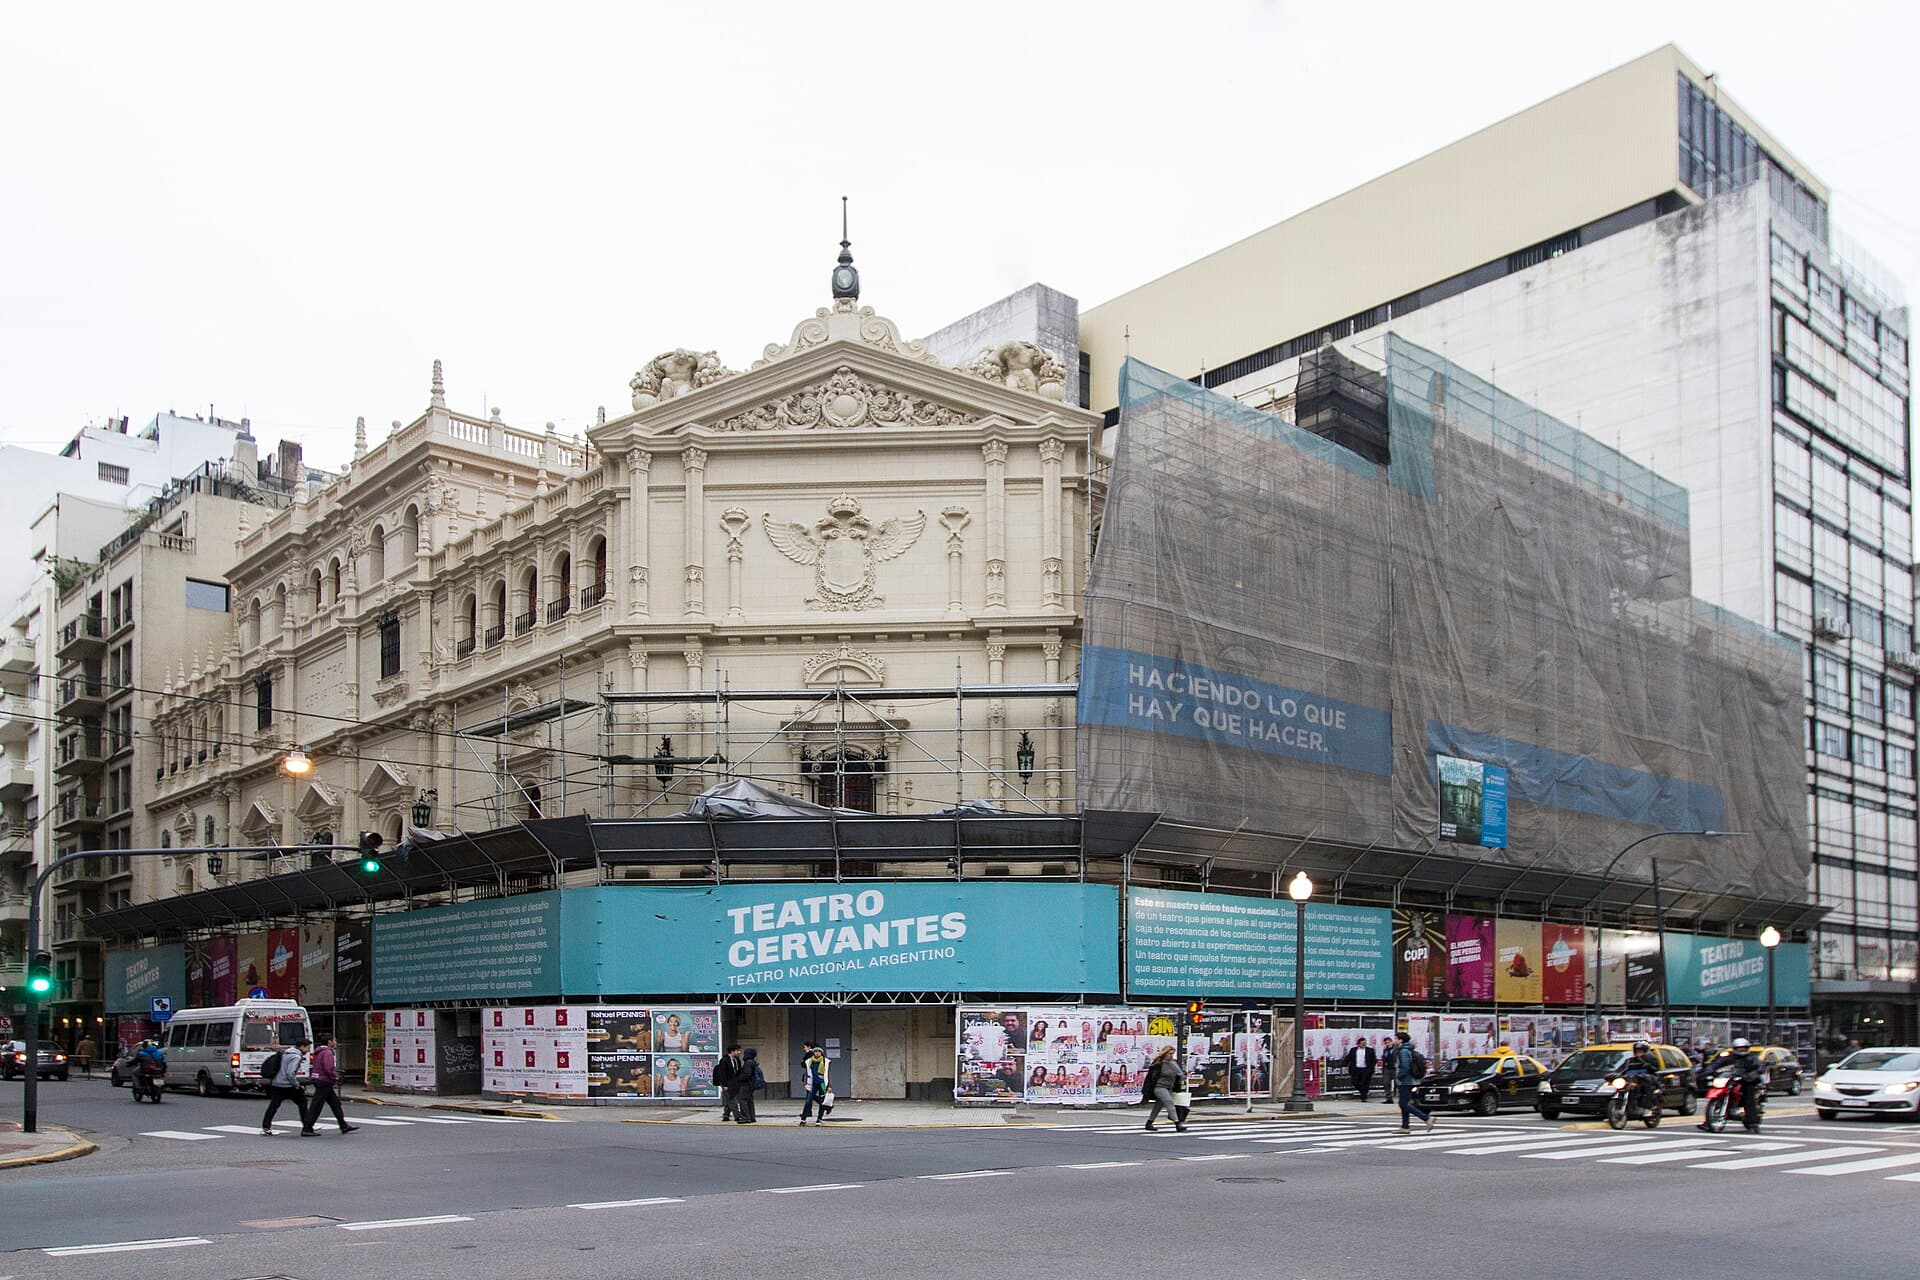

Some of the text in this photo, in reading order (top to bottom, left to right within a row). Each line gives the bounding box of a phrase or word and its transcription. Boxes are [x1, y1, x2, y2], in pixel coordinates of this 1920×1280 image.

[1130, 663, 1346, 730] HACIENDO LO QUE
[1129, 693, 1328, 752] HAY QUE HACER.
[728, 890, 884, 935] TEATRO
[1136, 910, 1145, 919] de
[1160, 913, 1183, 922] teatro
[1185, 916, 1199, 925] que
[1226, 917, 1232, 925] el
[1259, 921, 1272, 929] que
[1222, 905, 1246, 913] teatro
[1281, 908, 1297, 917] Desd
[728, 912, 966, 968] CERVANTES
[1154, 924, 1164, 933] de
[1210, 928, 1219, 936] de
[1221, 929, 1231, 937] los
[1136, 938, 1159, 946] teatro
[1162, 939, 1189, 948] abierto
[1700, 942, 1743, 965] TEATRO
[1136, 950, 1146, 959] Un
[1148, 952, 1172, 960] teatro
[1174, 954, 1188, 962] que
[728, 947, 955, 987] TEATRO NACIONAL ARGENTINO
[1135, 966, 1150, 974] que
[1180, 965, 1187, 974] el
[1214, 967, 1223, 975] de
[1224, 967, 1240, 975] todo
[1702, 956, 1764, 987] CERVANTES
[1135, 977, 1165, 988] espacio
[1167, 980, 1185, 988] para
